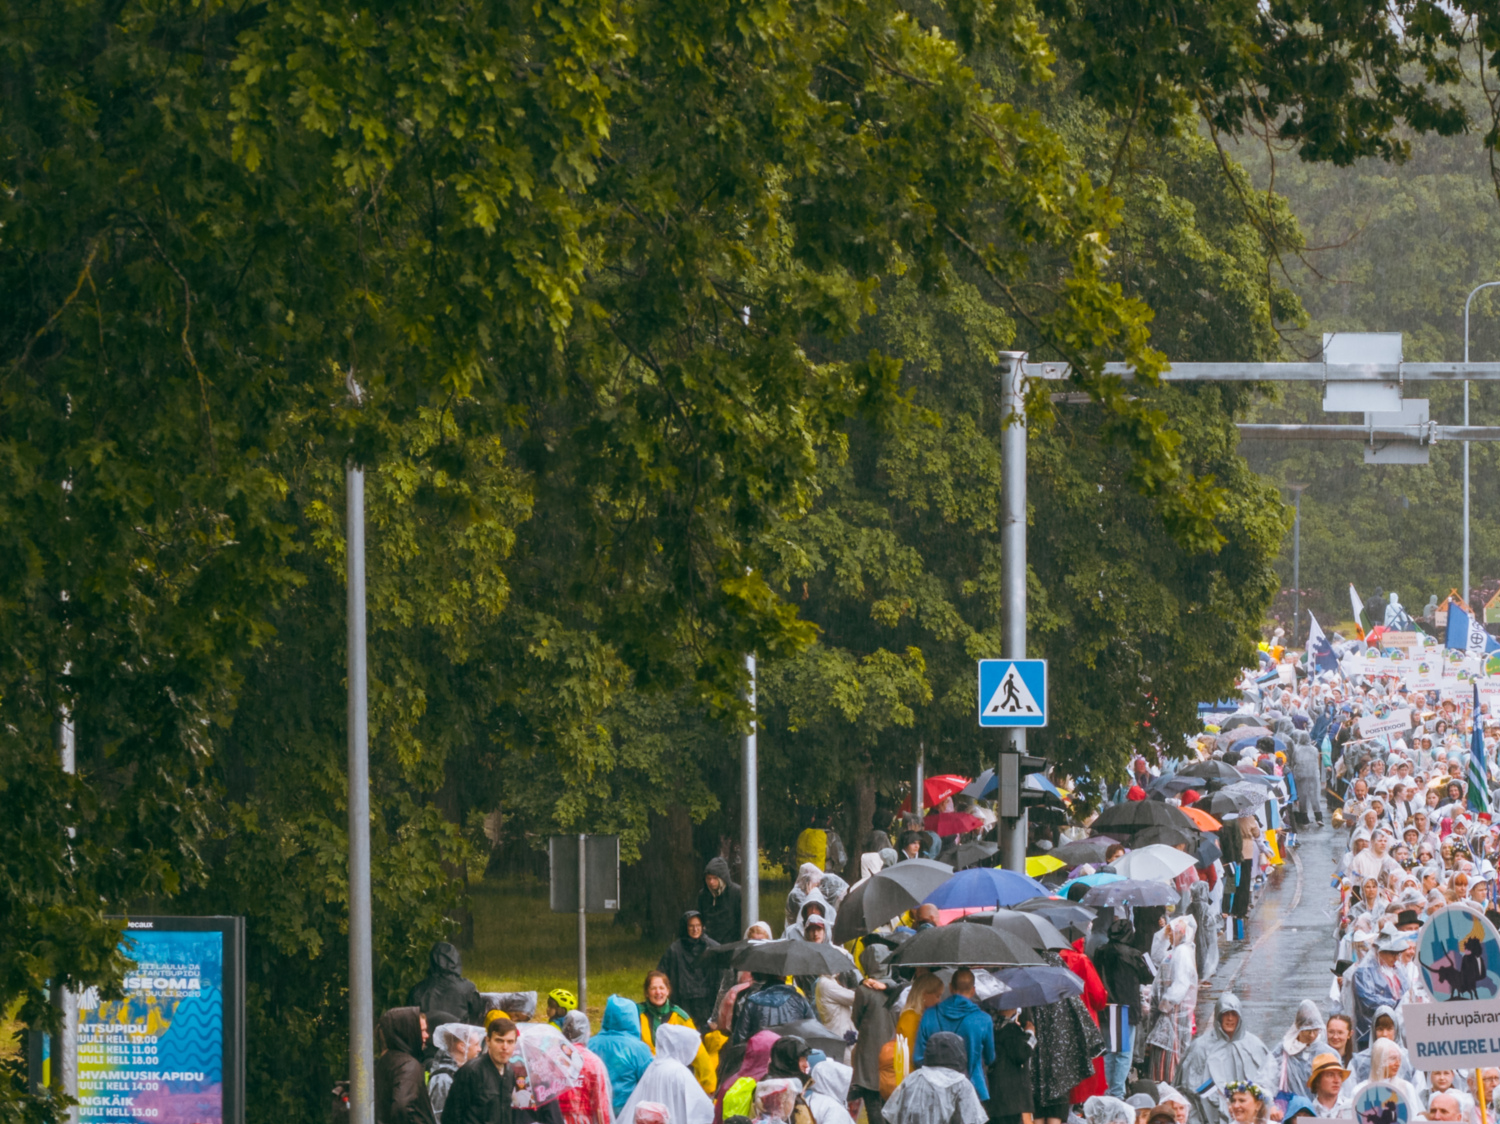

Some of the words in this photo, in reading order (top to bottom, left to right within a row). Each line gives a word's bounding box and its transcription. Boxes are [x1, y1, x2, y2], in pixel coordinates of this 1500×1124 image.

[78, 1023, 147, 1034] NTSUPIDU
[106, 1035, 130, 1044] KELL
[131, 1036, 159, 1044] 19.00
[106, 1046, 130, 1055] KELL
[131, 1047, 159, 1055] 11.00
[1416, 1038, 1488, 1058] RAKVERE
[106, 1056, 130, 1065] KELL
[131, 1057, 159, 1065] 18.00
[78, 1070, 205, 1082] HVAMUUSIKAPIDU
[106, 1082, 130, 1091] KELL
[131, 1083, 159, 1091] 14.00
[78, 1093, 135, 1107] NGKÄIK
[106, 1108, 130, 1117] KELL
[131, 1109, 159, 1117] 13.00
